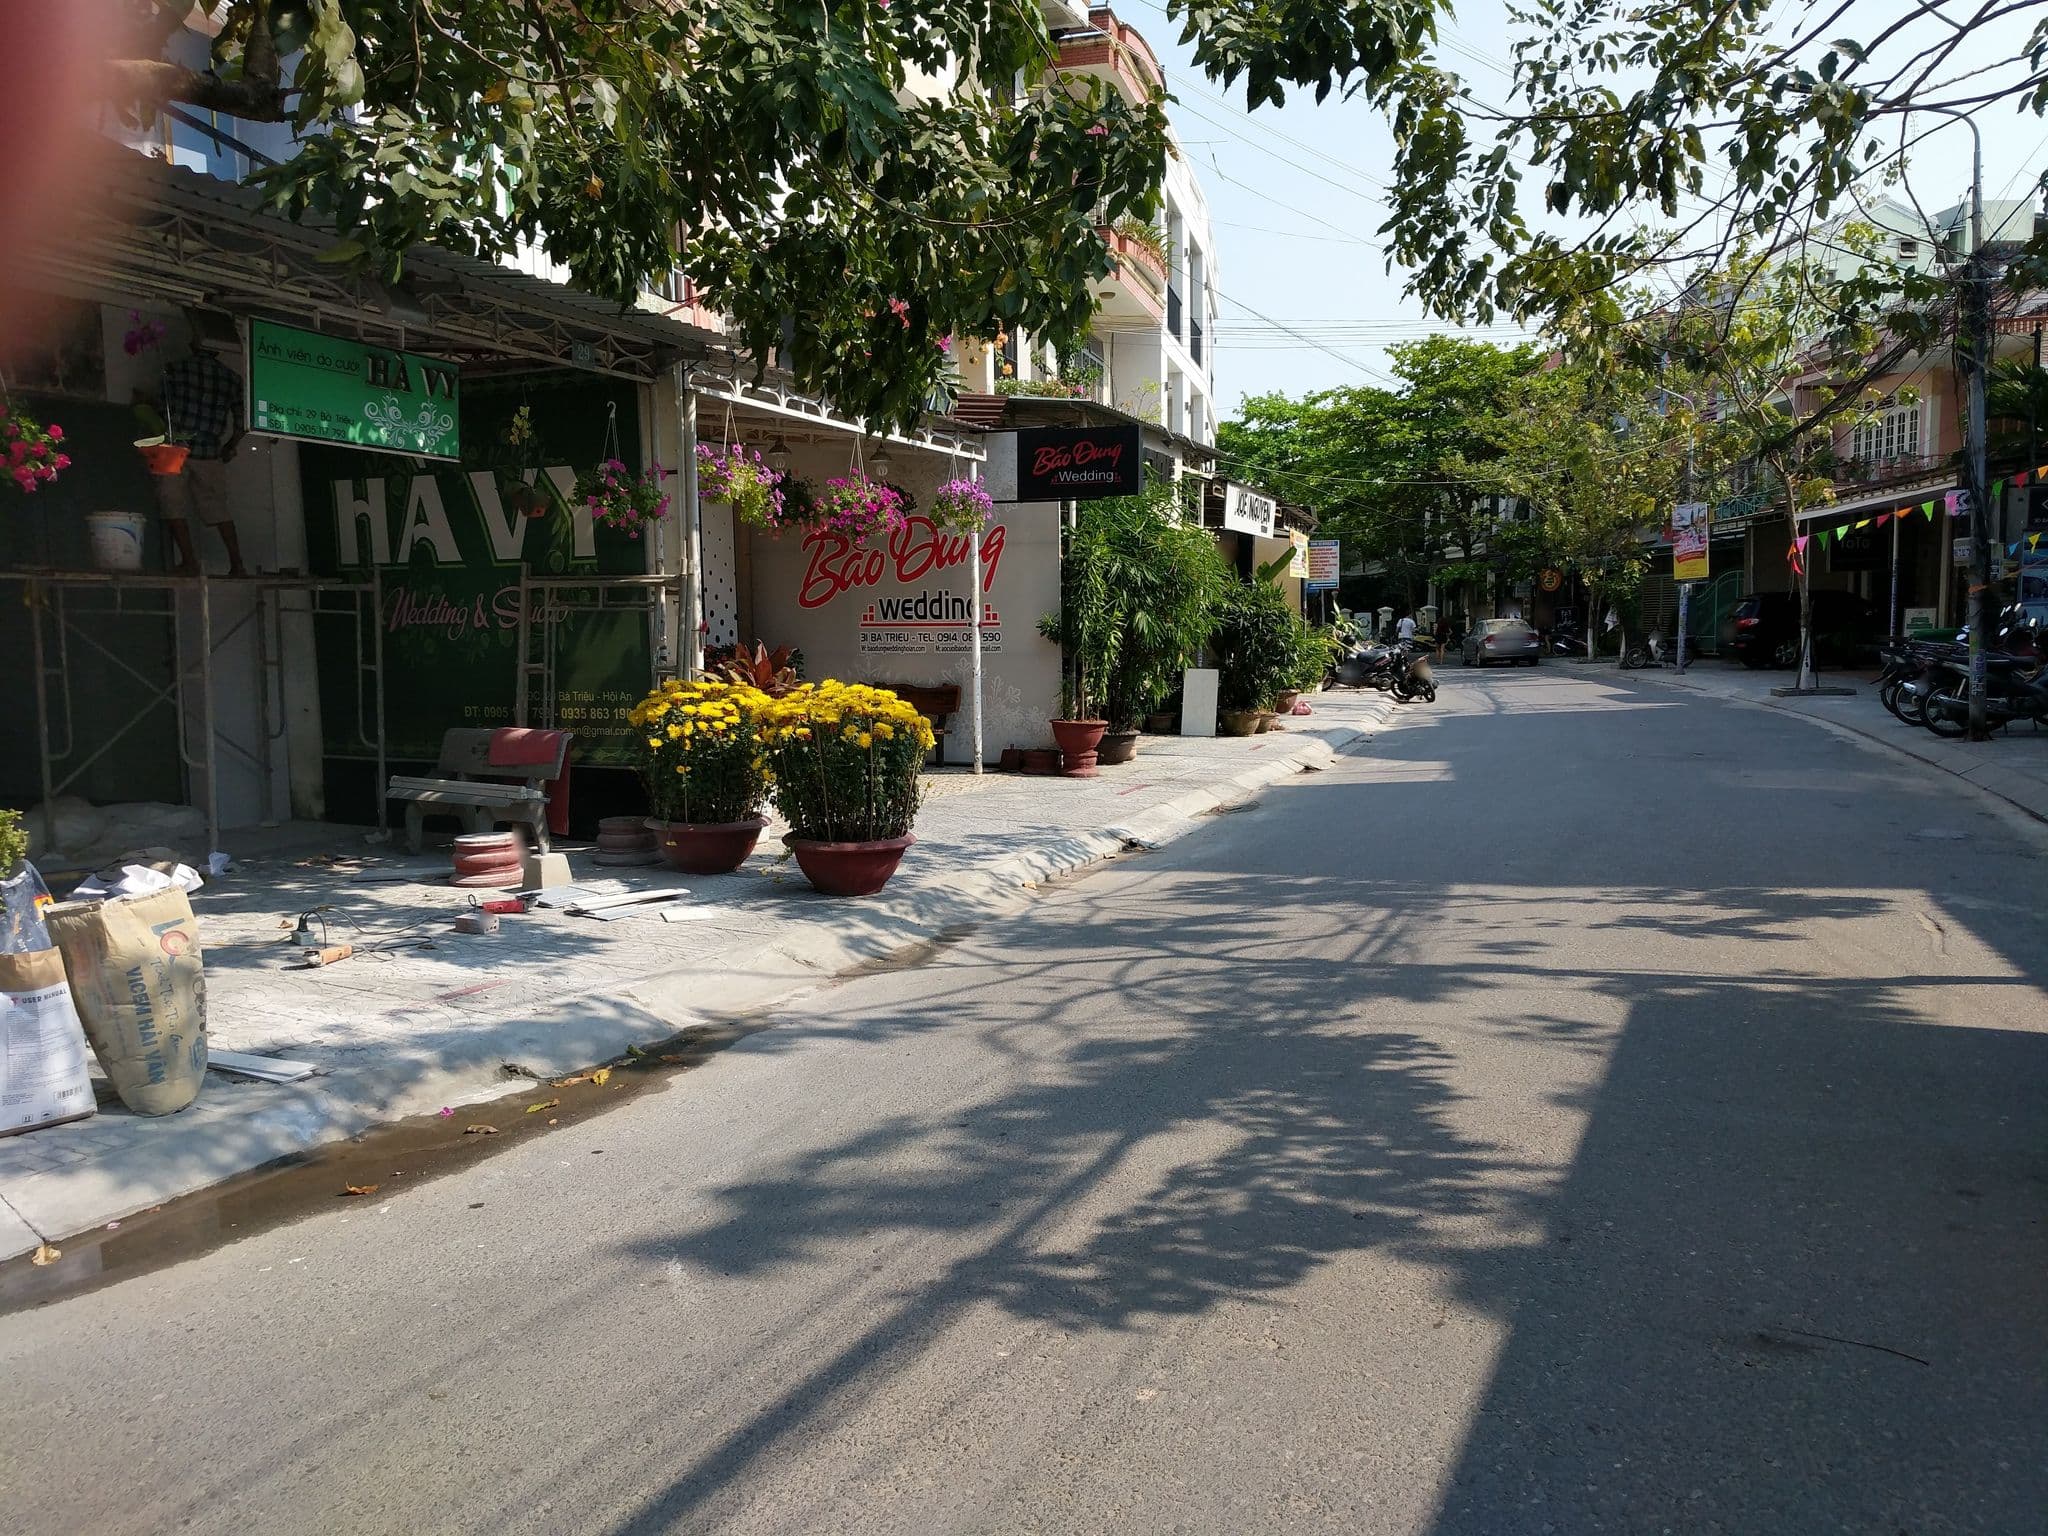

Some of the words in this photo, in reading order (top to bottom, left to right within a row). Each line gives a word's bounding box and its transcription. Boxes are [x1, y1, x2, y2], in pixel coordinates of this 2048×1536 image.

[577, 344, 590, 361] 29
[366, 351, 412, 393] HÀ
[306, 408, 317, 420] 29
[294, 423, 317, 435] 0905
[1058, 469, 1114, 483] Wedding
[383, 585, 469, 641] Wedding
[474, 592, 491, 629] &
[870, 633, 881, 642] BA
[885, 633, 909, 642] TRIEU
[620, 691, 633, 702] An
[484, 706, 509, 719] 0905
[561, 707, 587, 720] 0935
[590, 707, 610, 720] 863
[22, 995, 42, 1004] USER
